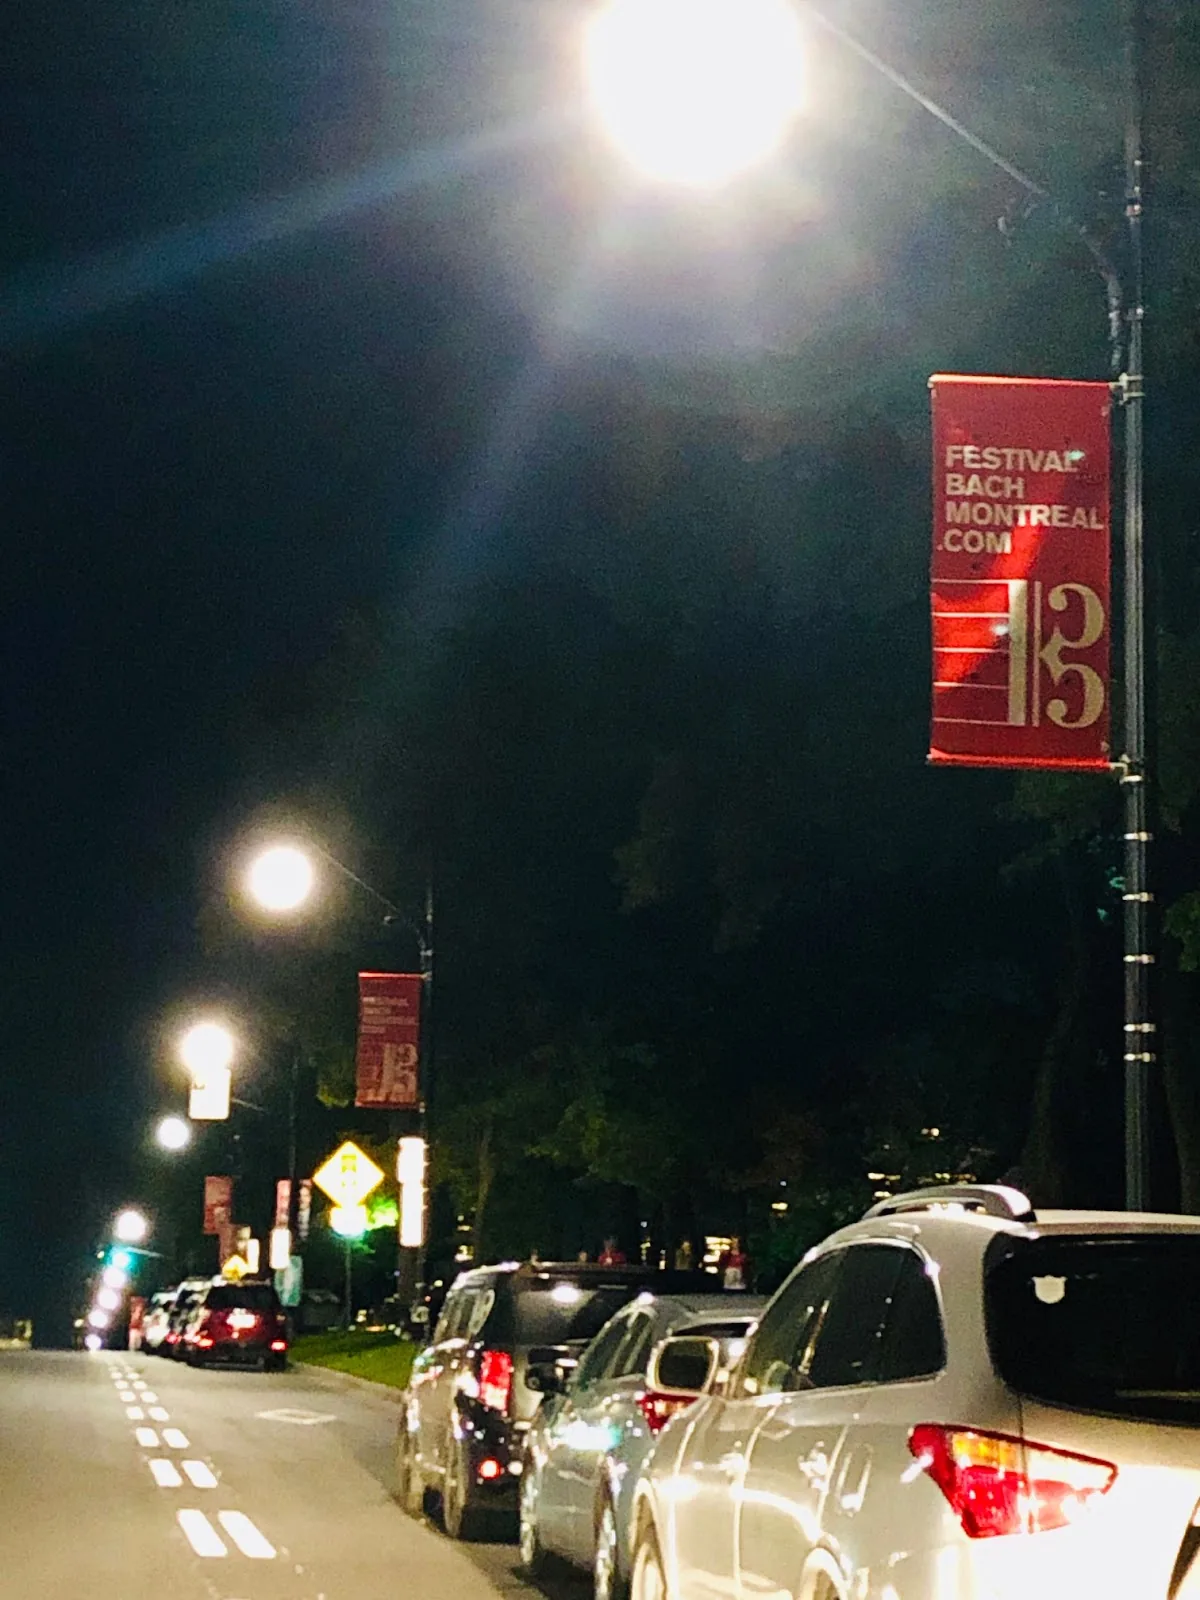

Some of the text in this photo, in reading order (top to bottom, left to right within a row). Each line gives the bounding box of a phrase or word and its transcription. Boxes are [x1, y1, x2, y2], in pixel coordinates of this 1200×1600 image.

[945, 473, 1024, 499] BACH
[945, 502, 1105, 530] MONTREAL
[936, 529, 1013, 554] .COM
